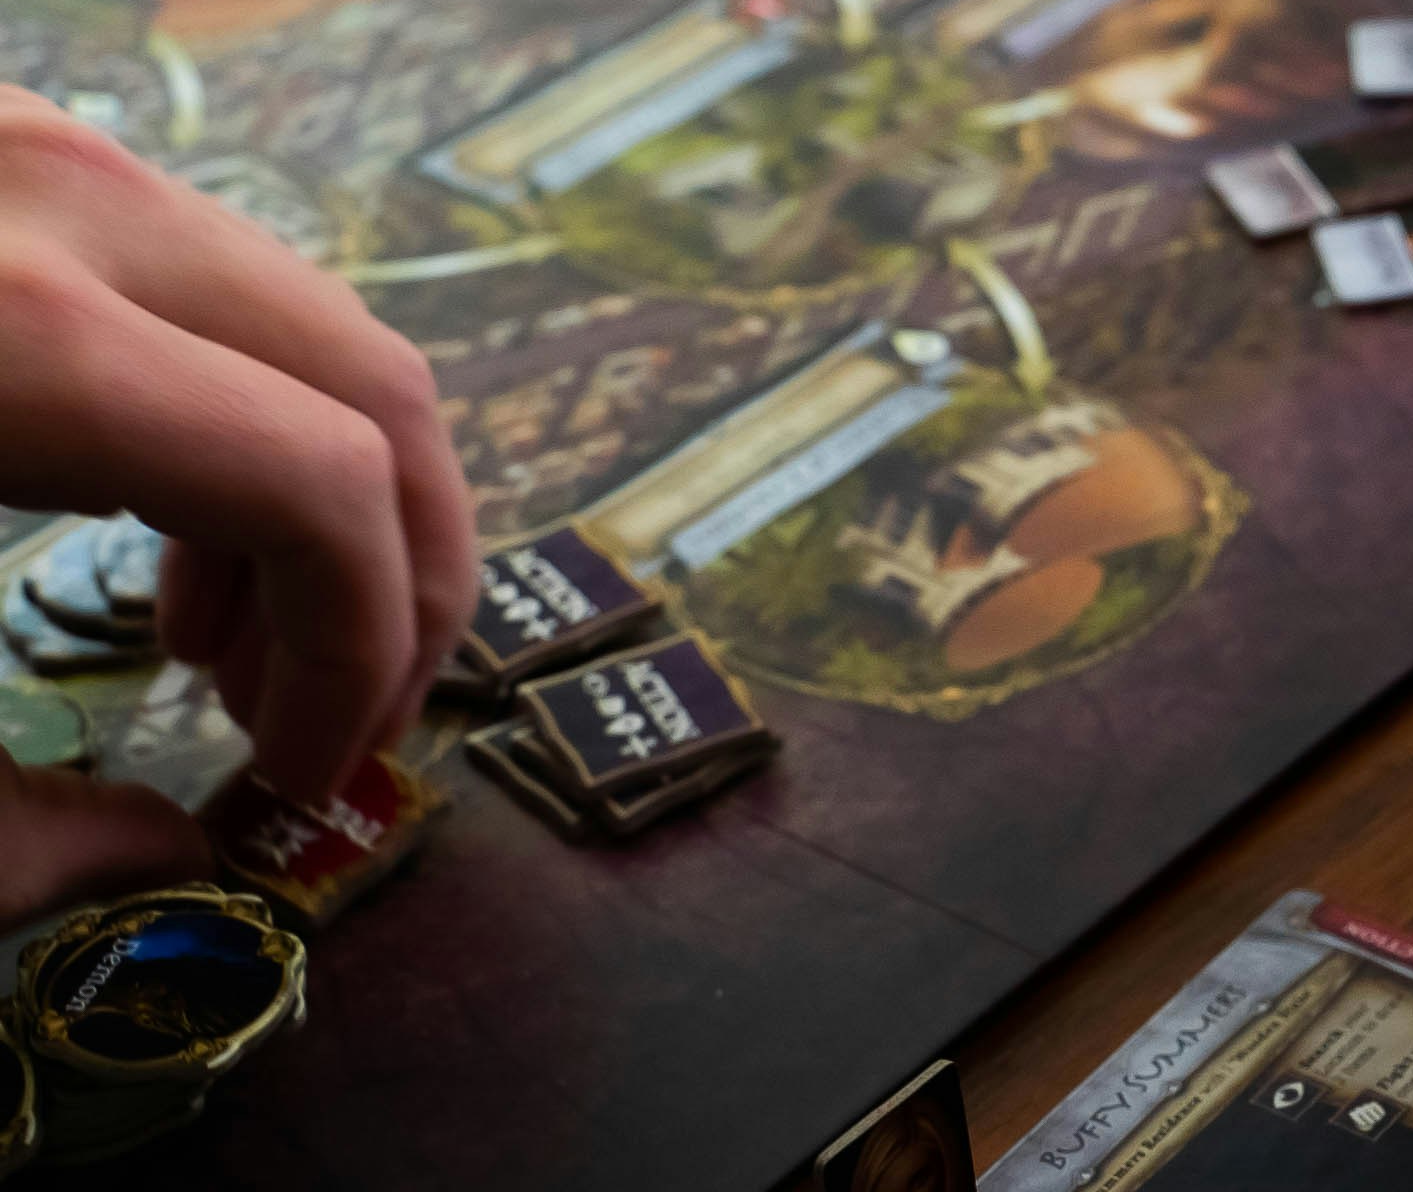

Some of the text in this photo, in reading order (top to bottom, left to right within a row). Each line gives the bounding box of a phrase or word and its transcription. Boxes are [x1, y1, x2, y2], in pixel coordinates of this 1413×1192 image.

[619, 660, 703, 743] ACTION
[65, 937, 141, 1014] Demon
[1039, 984, 1248, 1172] BUFFY SUMMERS
